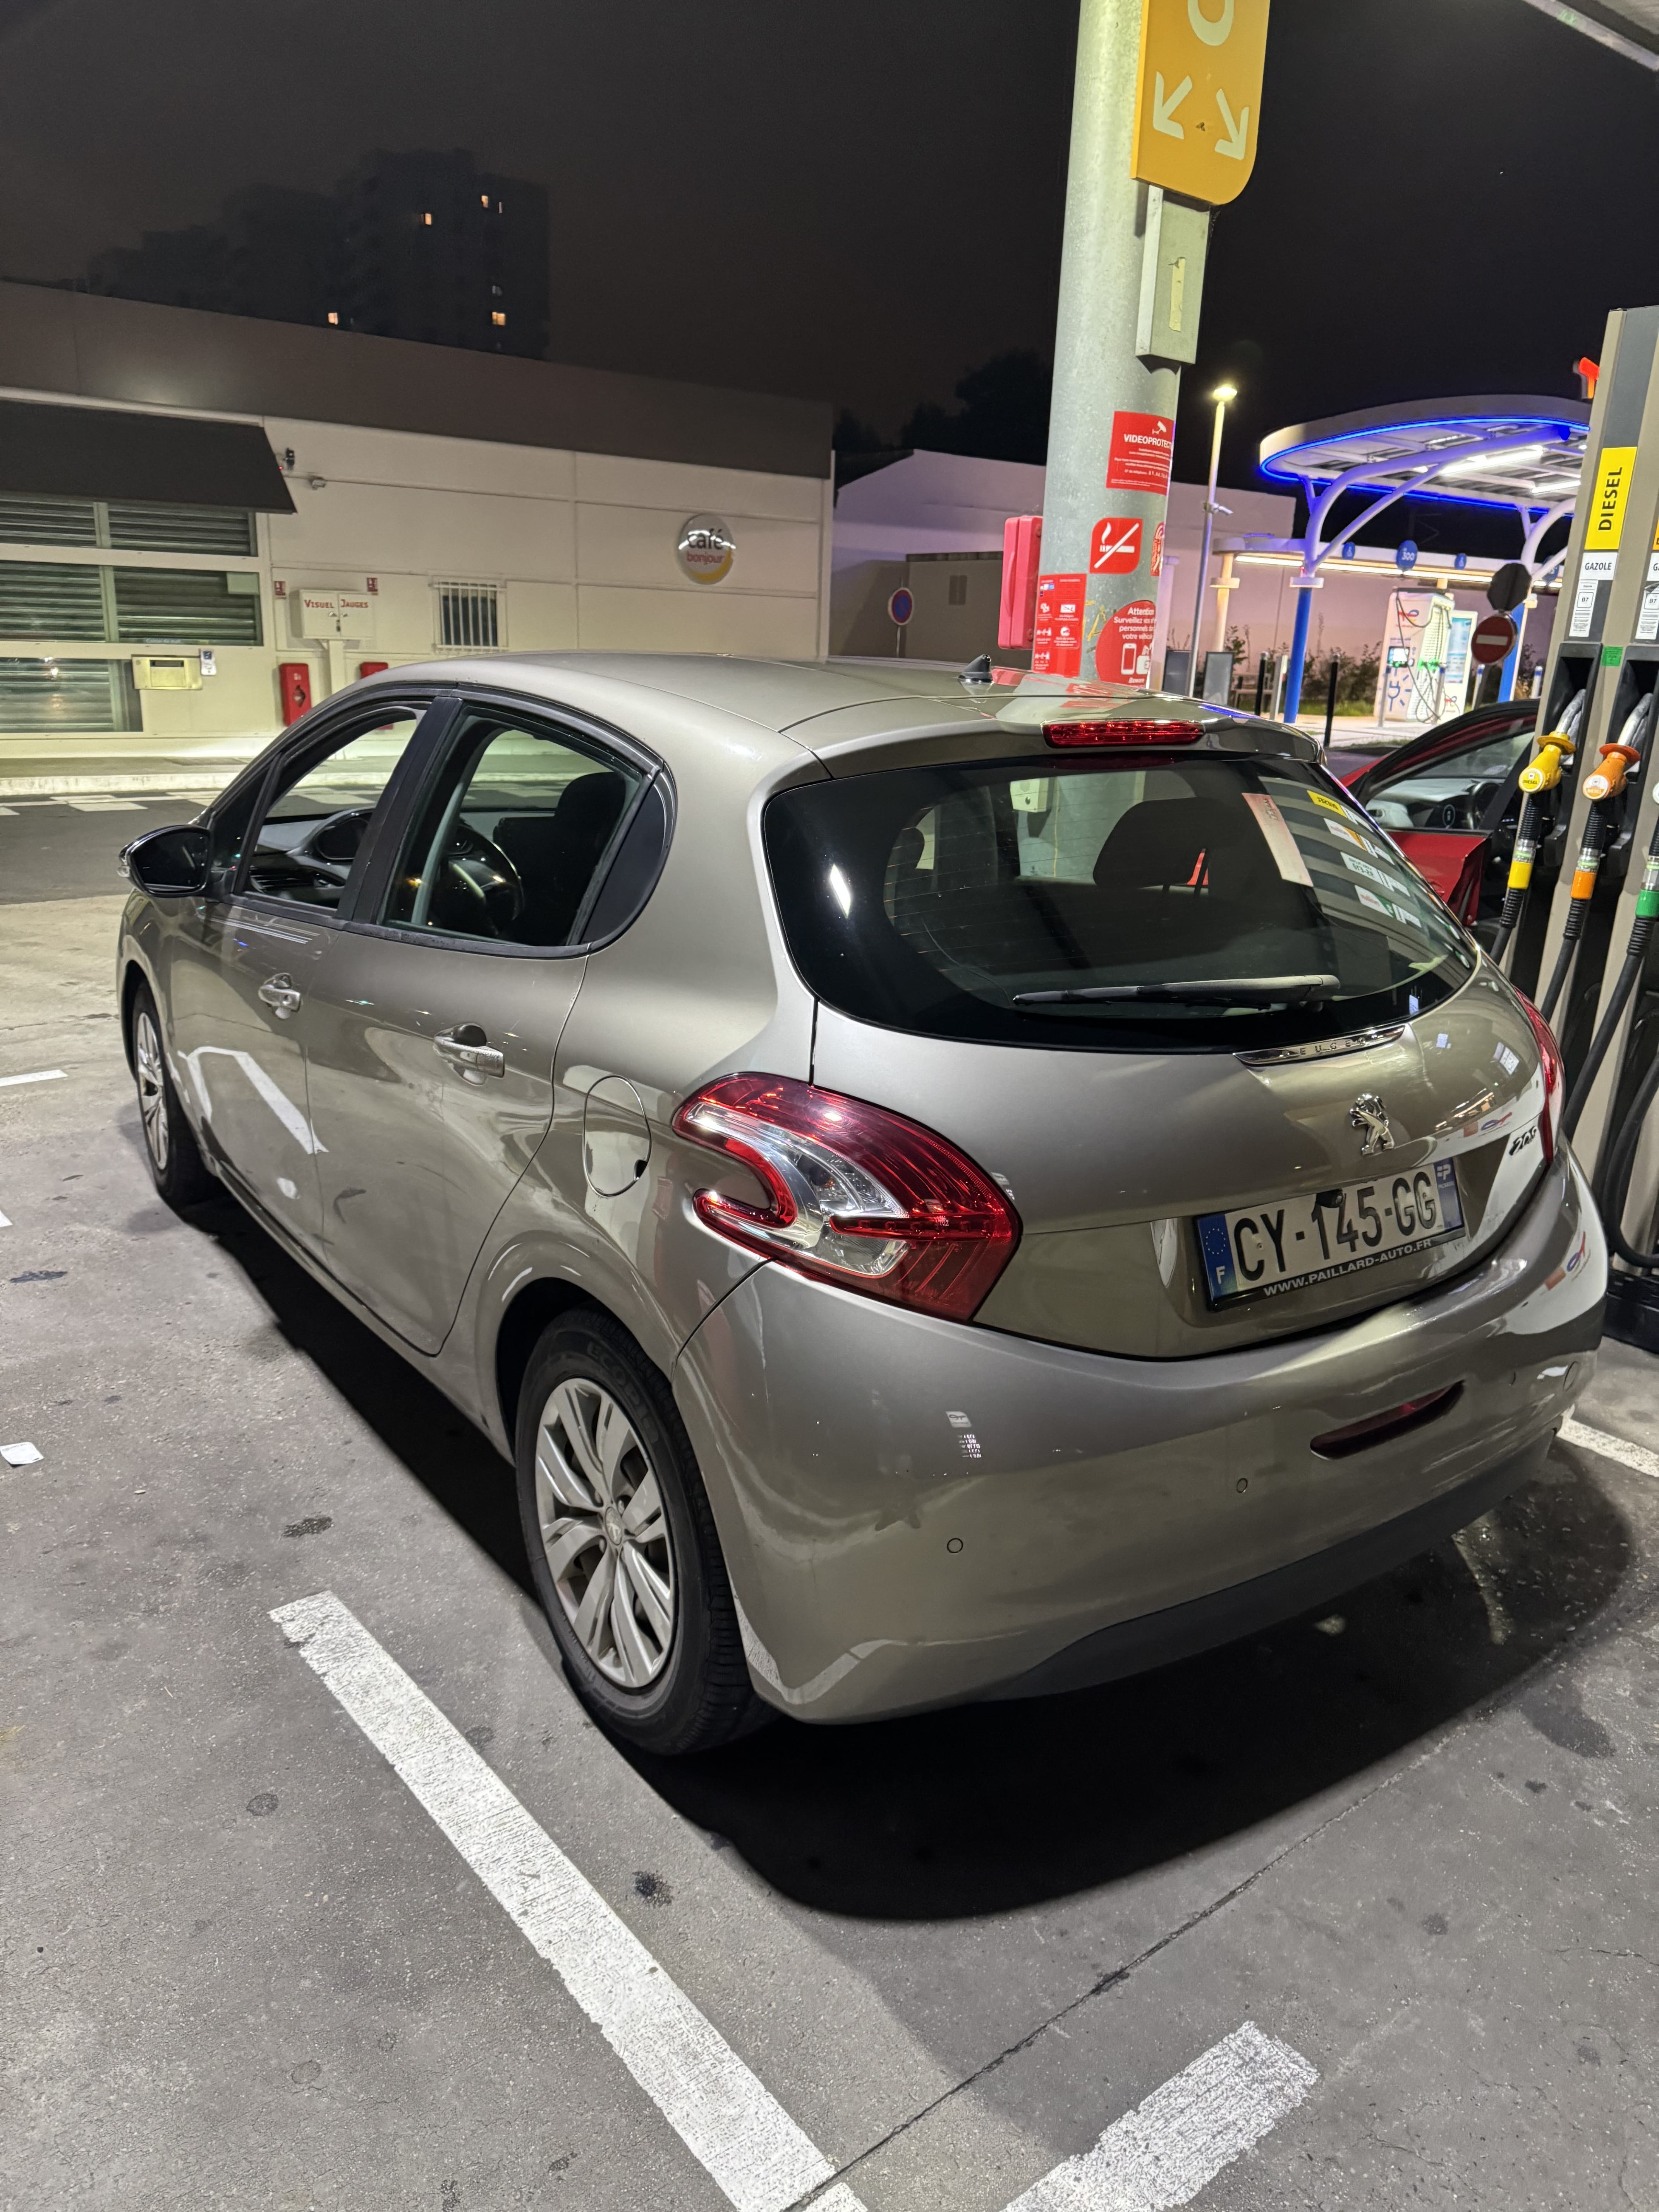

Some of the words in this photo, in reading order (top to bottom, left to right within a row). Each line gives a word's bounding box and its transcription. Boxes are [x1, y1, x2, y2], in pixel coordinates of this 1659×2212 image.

[1598, 467, 1622, 530] DIESEL
[688, 528, 723, 550] café
[687, 552, 725, 565] bonjour
[1402, 552, 1415, 561] 300
[1585, 562, 1612, 570] GAZOLE
[1234, 1171, 1437, 1281] CY-145-GG
[1216, 1265, 1226, 1284] F
[1263, 1239, 1432, 1296] WWW.PAILLARD-AUTO.FR
